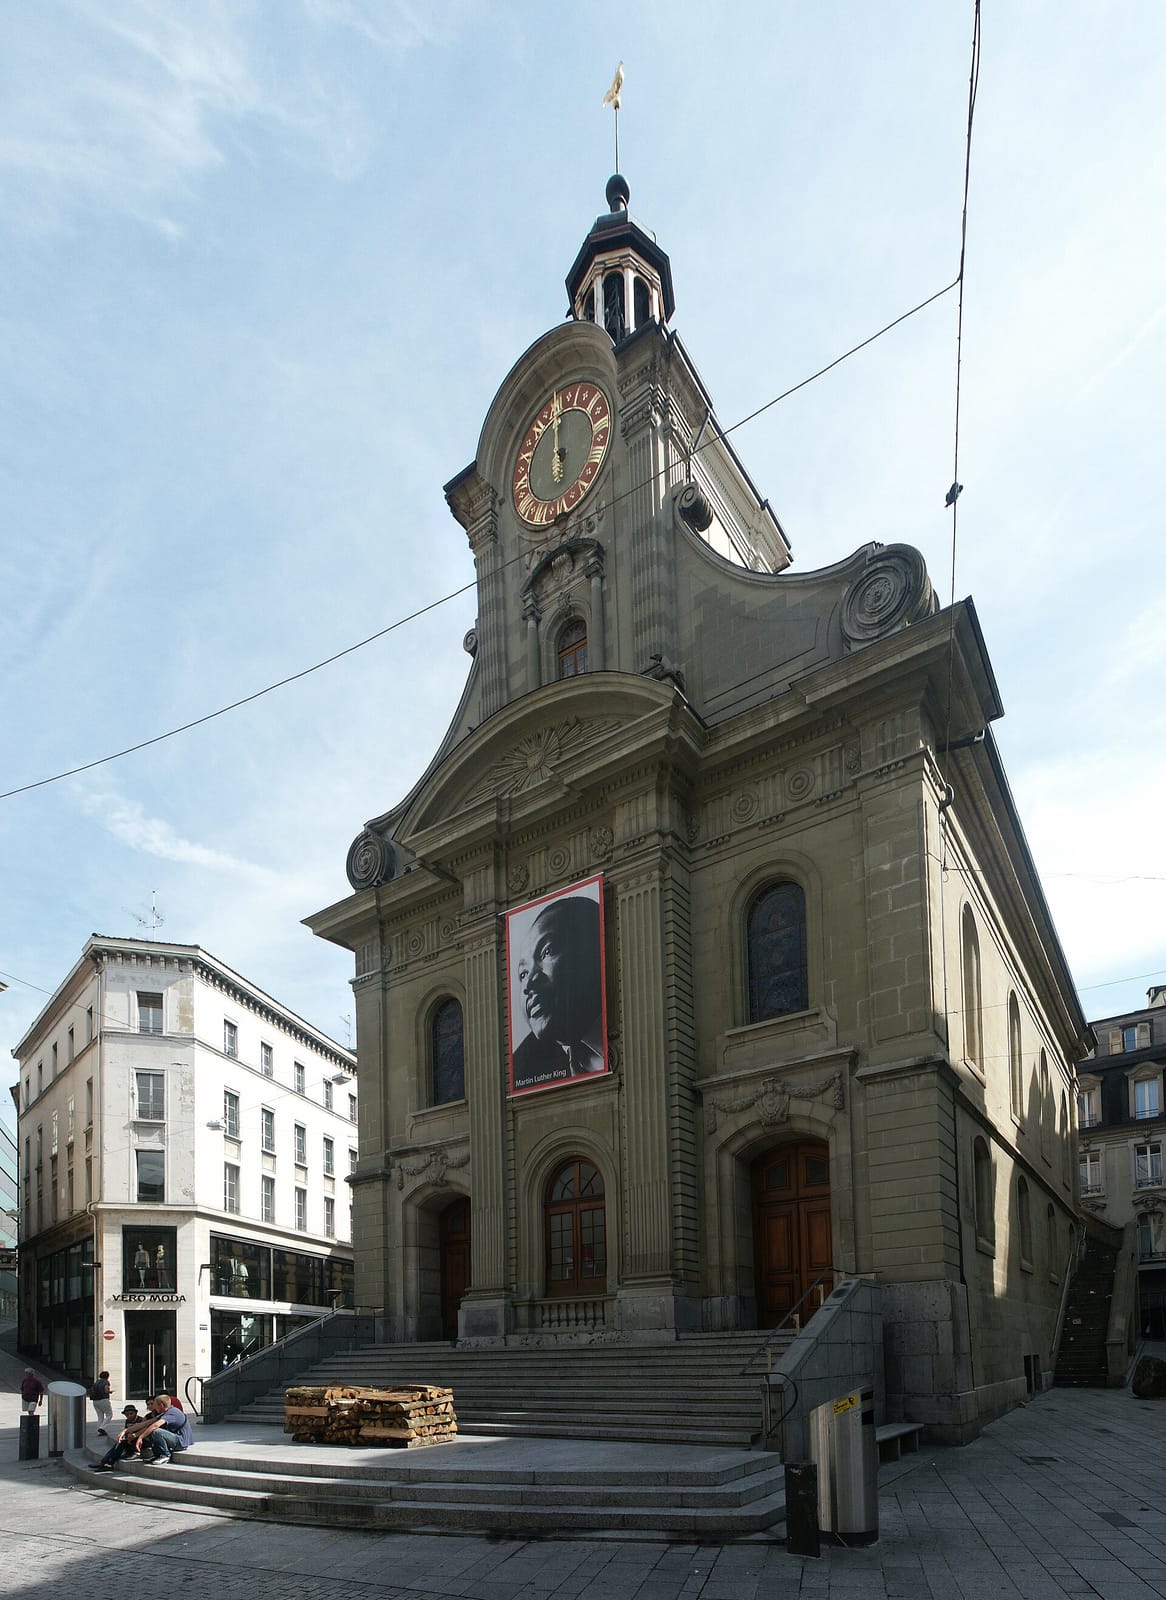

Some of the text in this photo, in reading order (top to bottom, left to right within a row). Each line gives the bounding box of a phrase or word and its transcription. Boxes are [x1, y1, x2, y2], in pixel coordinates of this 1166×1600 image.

[587, 390, 602, 412] II
[593, 414, 609, 432] III
[519, 451, 533, 465] X
[515, 1069, 566, 1087] Martin Luther King
[112, 1294, 186, 1302] VERO MODA
